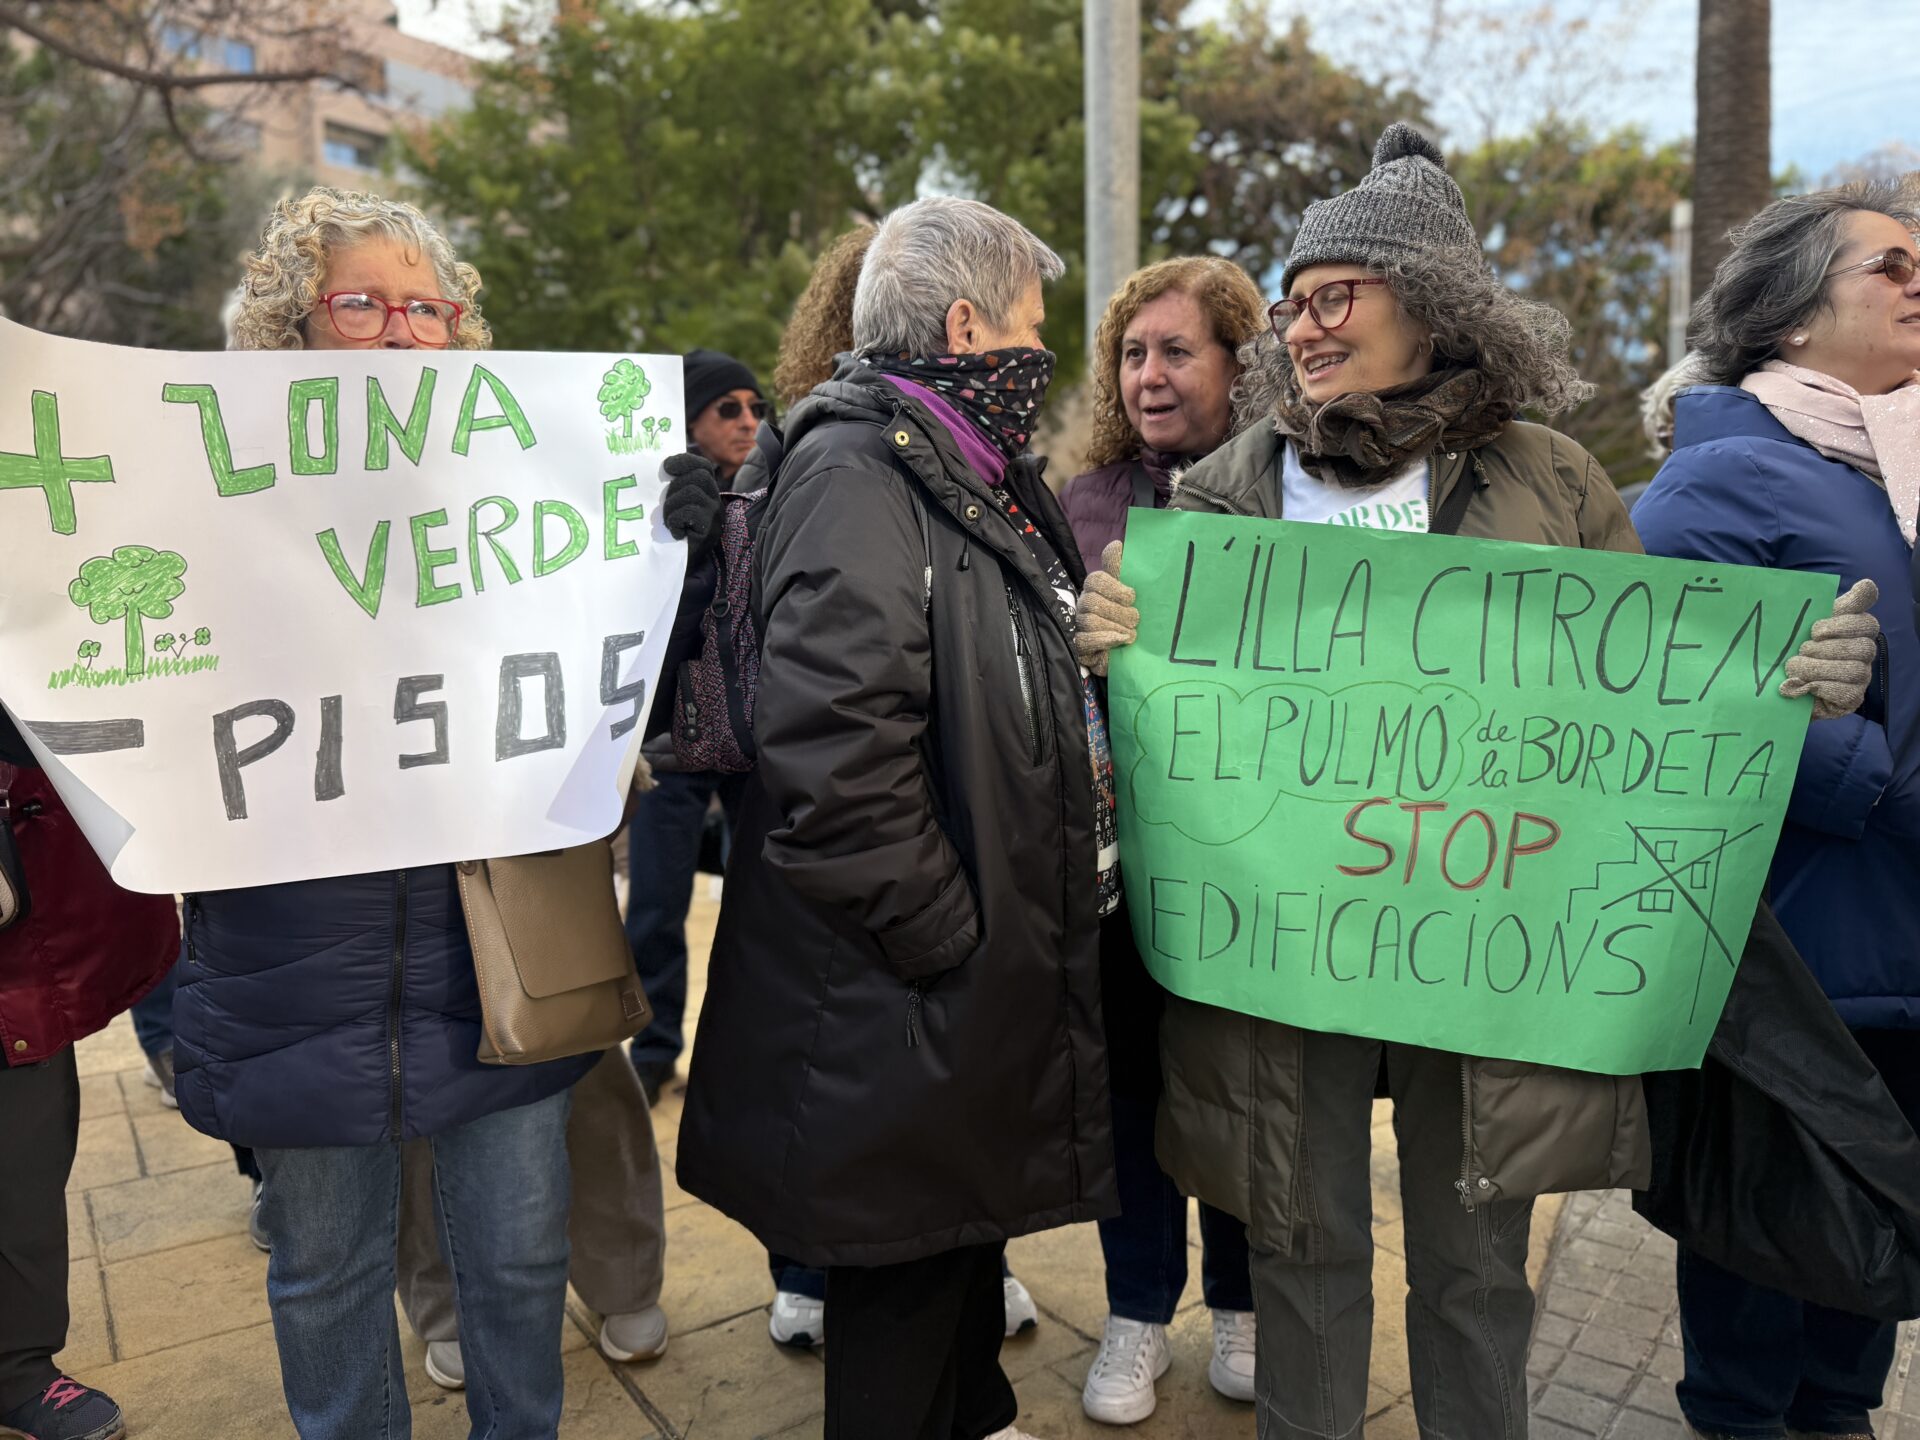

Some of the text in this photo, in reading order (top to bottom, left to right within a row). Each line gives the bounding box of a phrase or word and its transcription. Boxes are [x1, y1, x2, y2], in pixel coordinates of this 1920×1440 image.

[162, 363, 537, 497] ZONA
[316, 474, 644, 619] VERDE
[1412, 565, 1812, 705] CITROËN
[212, 630, 646, 821] PISOS
[1167, 694, 1242, 782] EL
[1256, 692, 1456, 798] PULMÓ
[1468, 750, 1508, 789] la
[1477, 708, 1517, 743] de
[1517, 716, 1774, 800] BORDETA
[1337, 799, 1560, 890] STOP
